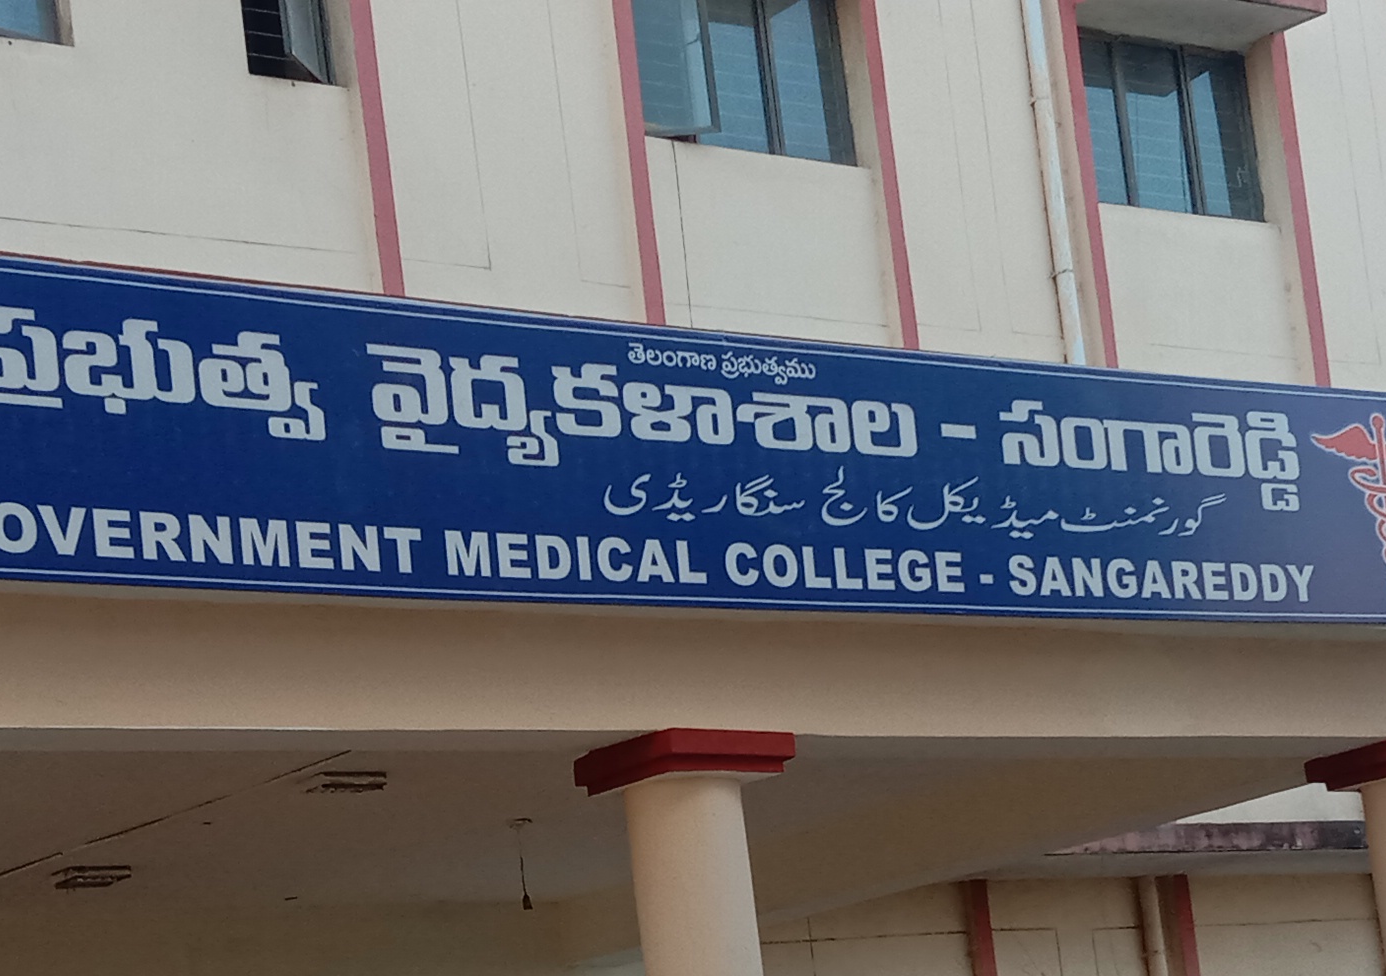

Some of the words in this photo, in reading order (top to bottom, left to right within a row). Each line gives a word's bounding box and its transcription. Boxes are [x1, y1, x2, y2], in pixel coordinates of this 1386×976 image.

[627, 342, 717, 371] తెలంగాణ
[720, 351, 816, 385] ప్రభుత్వము
[998, 399, 1301, 512] సంగారెడ్డి
[444, 530, 707, 584] MEDICAL
[724, 541, 966, 593] COLLEGE
[1007, 554, 1315, 602] SANGAREDDY
